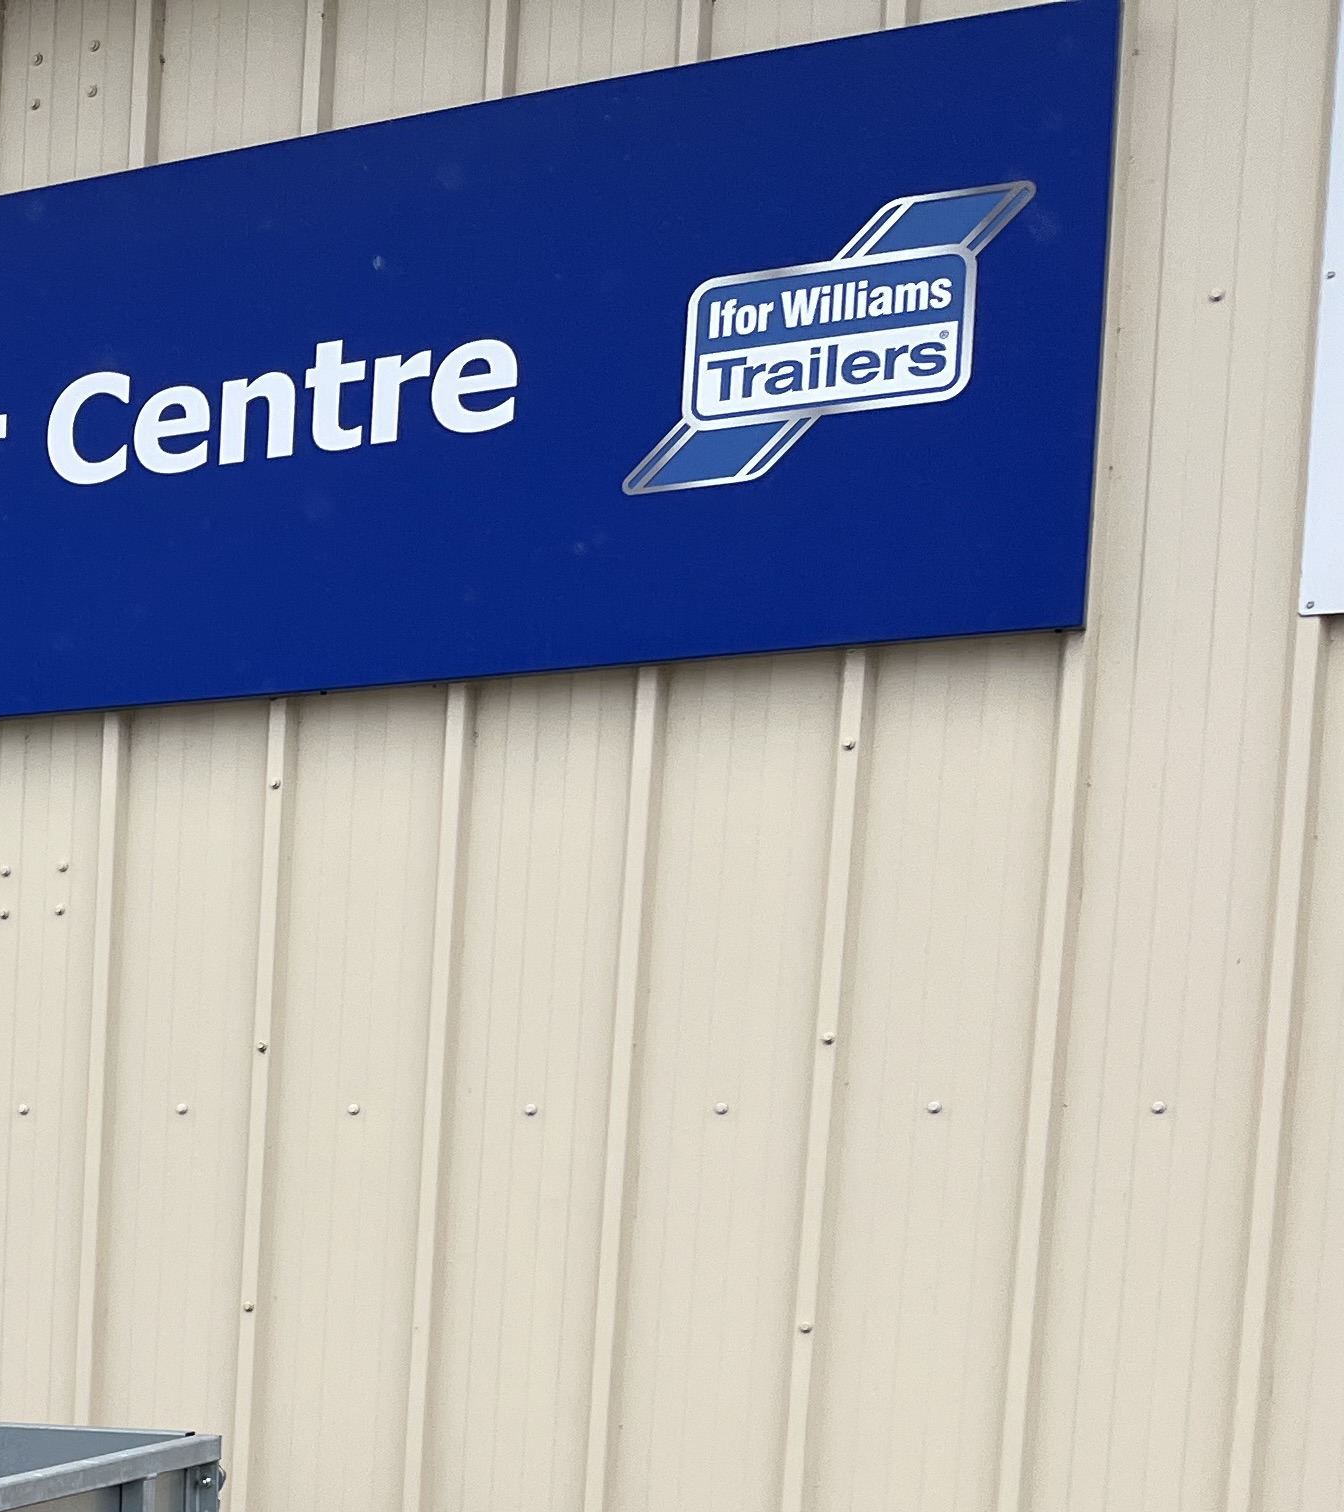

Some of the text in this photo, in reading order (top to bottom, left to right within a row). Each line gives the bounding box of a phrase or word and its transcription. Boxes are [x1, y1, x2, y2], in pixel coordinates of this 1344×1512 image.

[708, 277, 953, 340] Ifor Williams
[706, 343, 947, 402] Trailers
[48, 338, 518, 485] Centre
